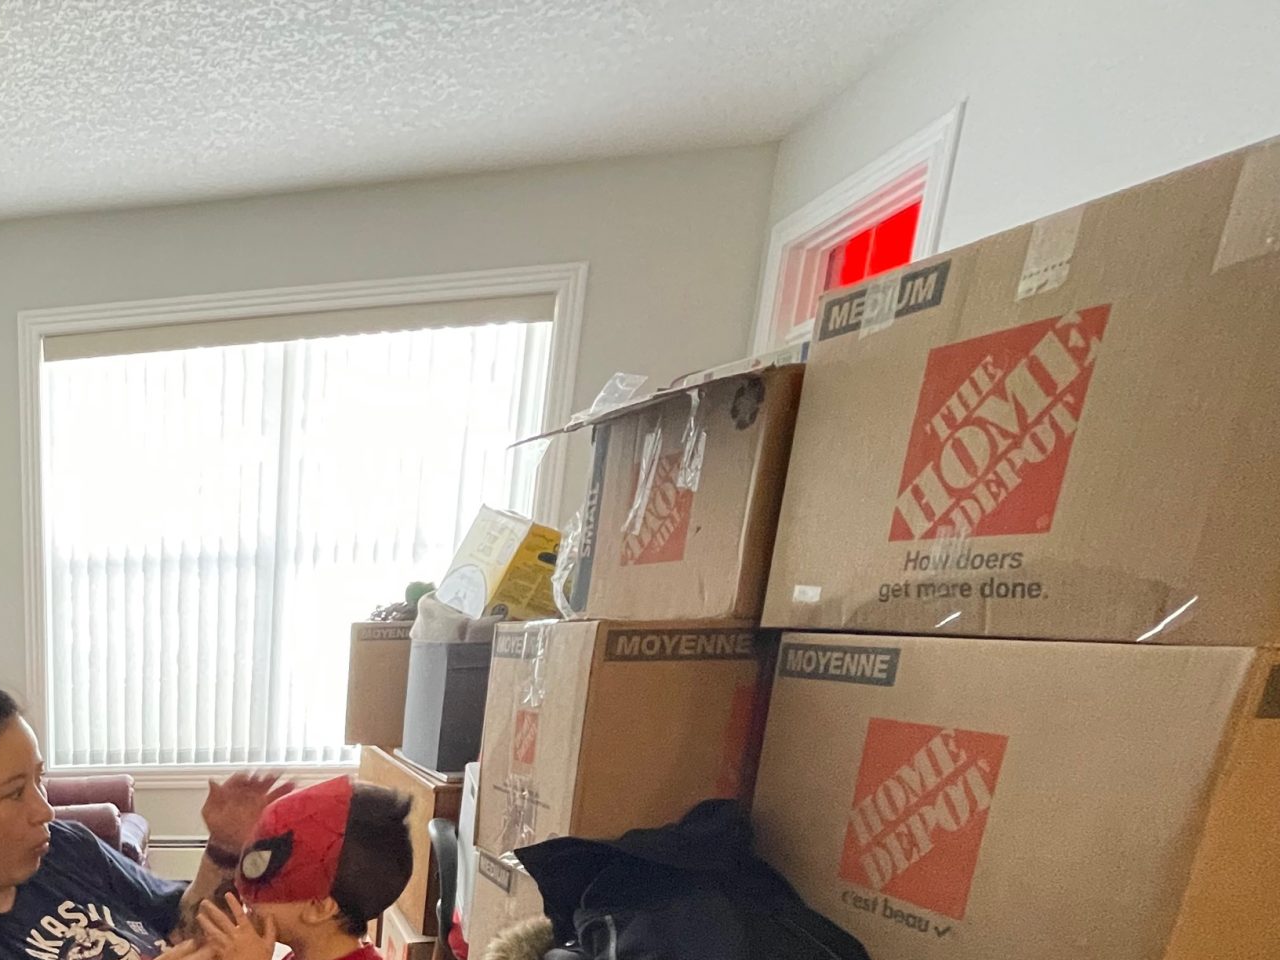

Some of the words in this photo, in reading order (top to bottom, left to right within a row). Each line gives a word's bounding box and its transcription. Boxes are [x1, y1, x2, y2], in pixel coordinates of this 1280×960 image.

[828, 272, 938, 331] MEDIUM
[893, 312, 1102, 537] HOME
[924, 354, 1003, 442] THE
[949, 395, 1078, 537] DEPOT
[903, 551, 950, 571] How
[956, 548, 1023, 571] doers
[878, 581, 912, 603] get
[917, 582, 972, 598] more
[980, 577, 1048, 599] done.
[616, 633, 753, 656] MOYENNE
[786, 649, 891, 679] MOYENNE
[850, 728, 967, 846] HOME
[861, 759, 993, 892] DEPOT
[882, 898, 929, 932] beau
